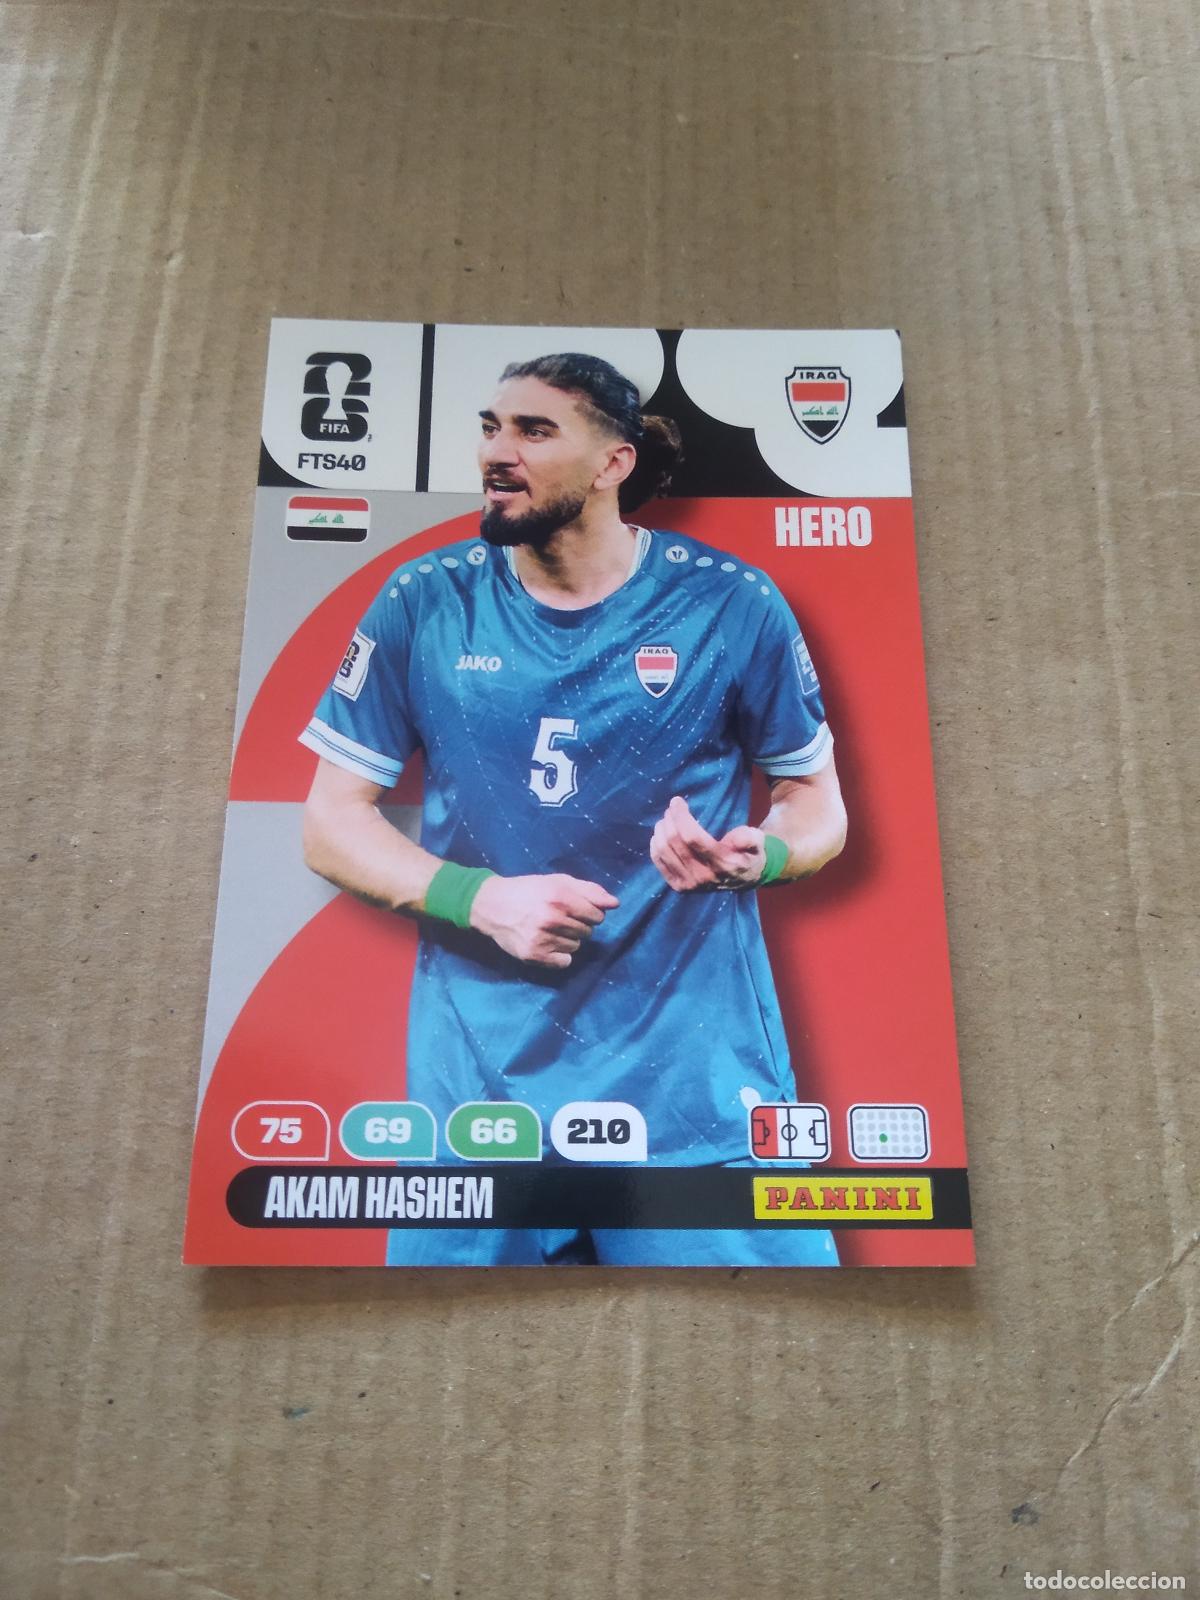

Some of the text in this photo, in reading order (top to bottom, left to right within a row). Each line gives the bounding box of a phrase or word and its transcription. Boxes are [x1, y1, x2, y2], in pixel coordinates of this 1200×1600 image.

[800, 371, 838, 380] IRAQ
[319, 423, 350, 434] FIFA
[297, 453, 366, 472] FTS40
[775, 506, 872, 547] HERO
[455, 655, 502, 672] JAKO
[528, 717, 580, 808] 5
[260, 1117, 302, 1144] 75
[364, 1117, 412, 1144] 69
[470, 1117, 518, 1145] 66
[567, 1118, 631, 1145] 210
[264, 1175, 494, 1219] AKAM HASHEM
[765, 1186, 922, 1211] PANINI
